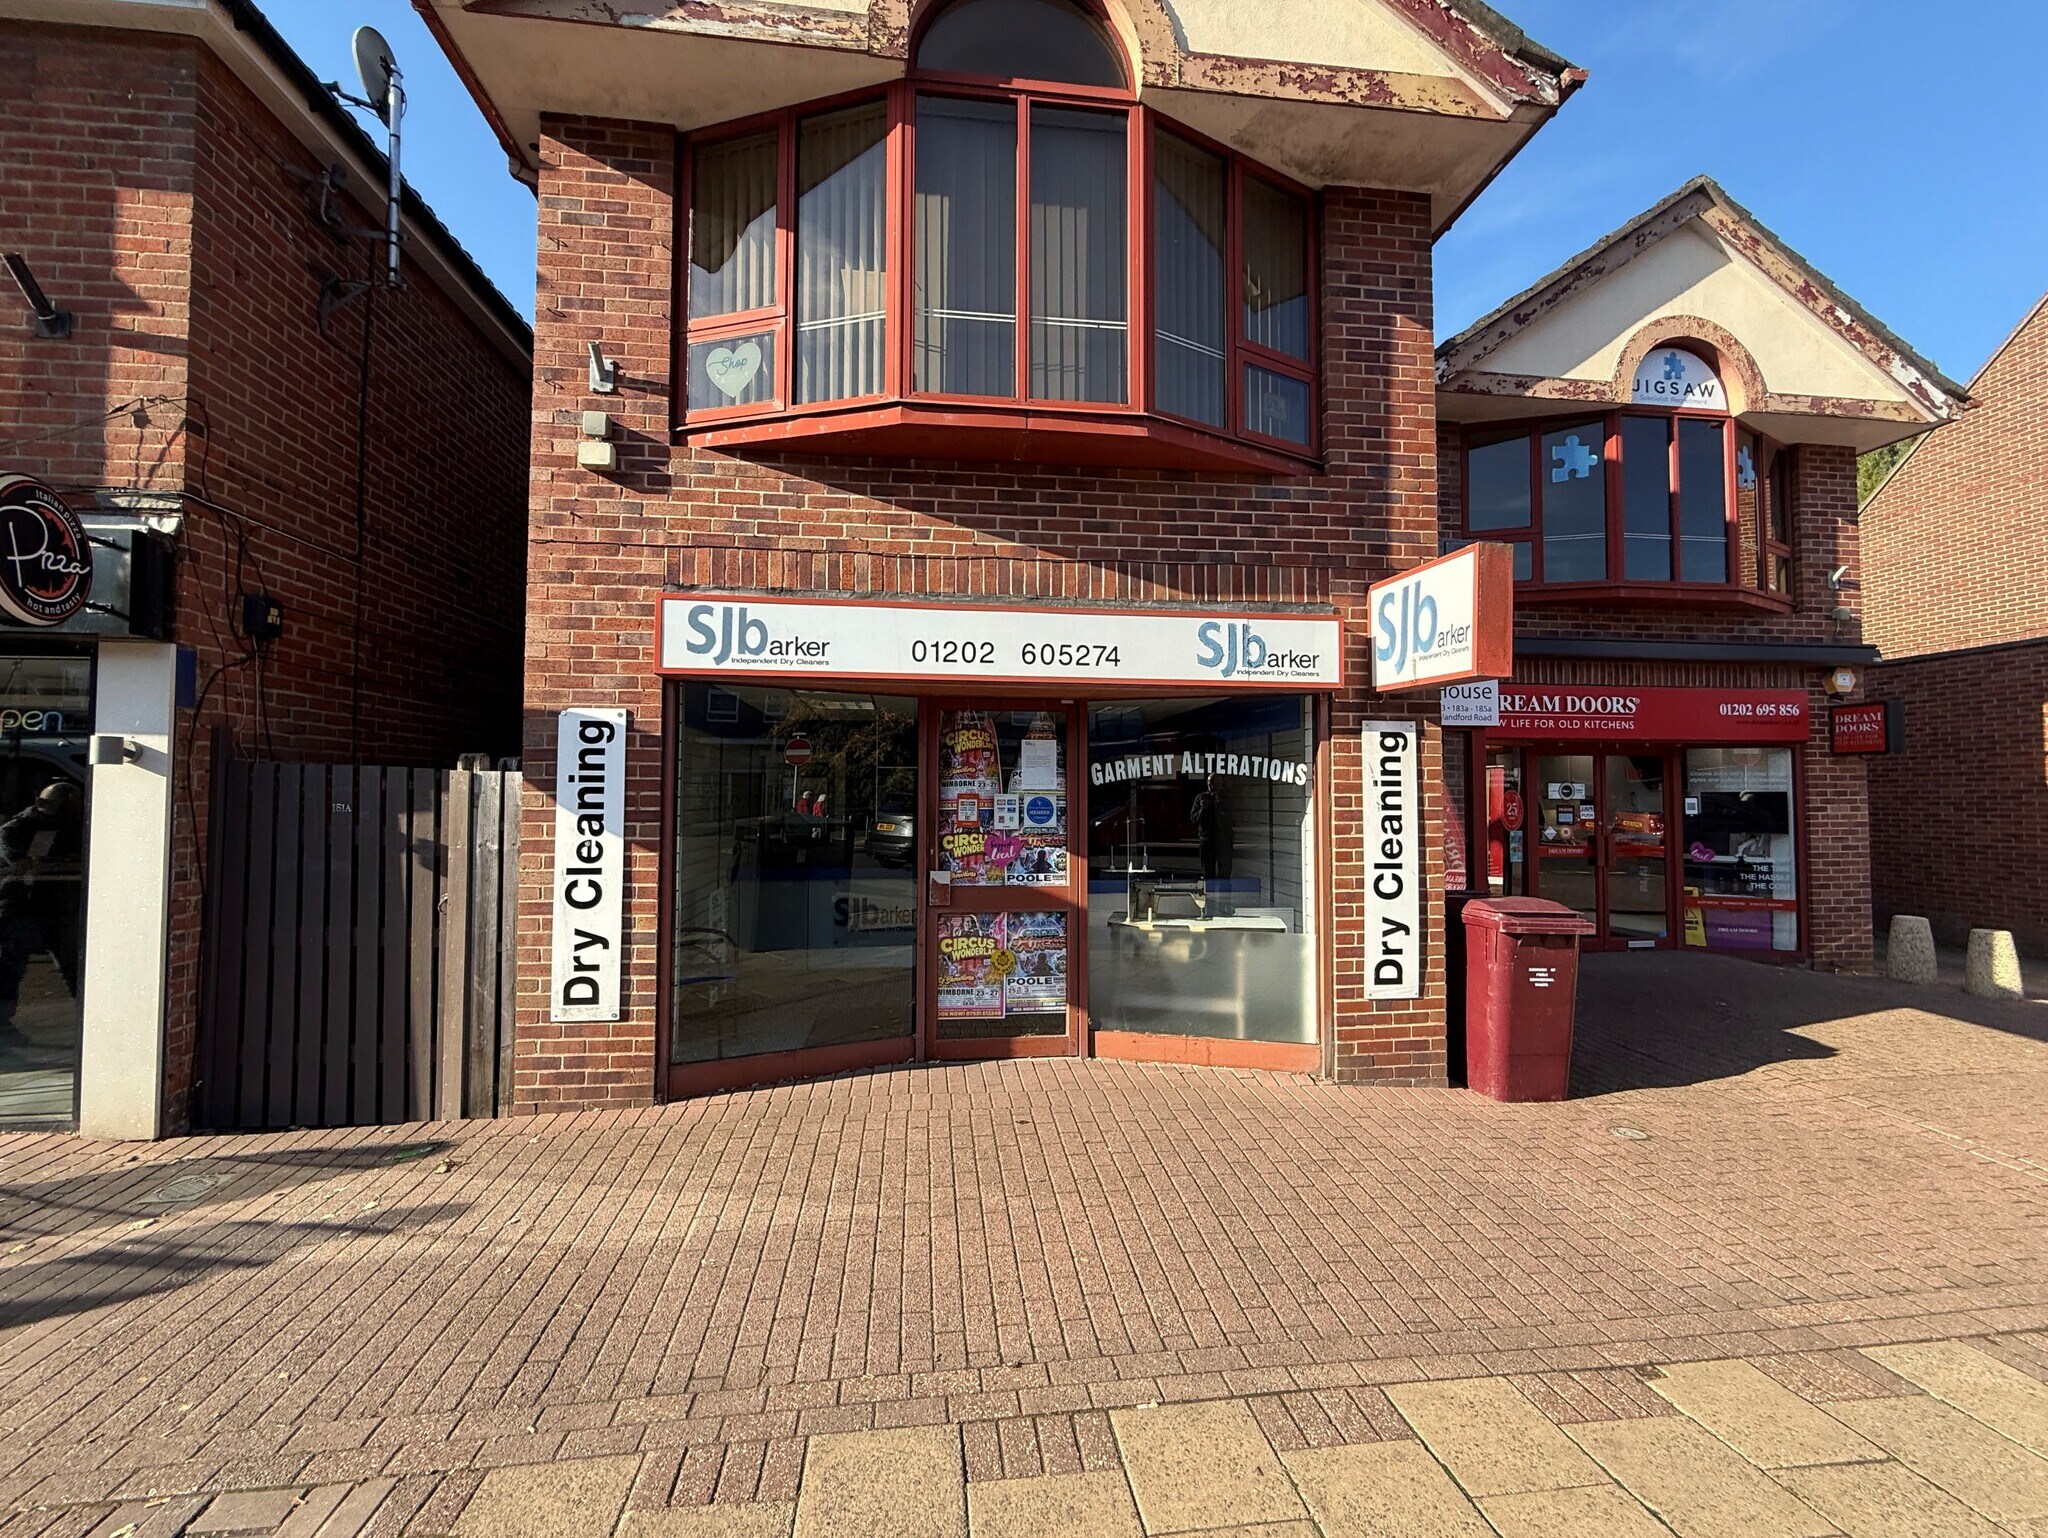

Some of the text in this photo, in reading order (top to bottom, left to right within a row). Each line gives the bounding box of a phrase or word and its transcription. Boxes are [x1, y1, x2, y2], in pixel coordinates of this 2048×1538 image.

[1632, 379, 1715, 397] JIGSAW
[35, 489, 64, 513] Italian
[26, 592, 81, 614] hot and tasty
[911, 640, 1121, 667] 01202 605274
[731, 657, 830, 667] Independent Dry Cleaners
[1236, 669, 1275, 677] Independent
[1277, 670, 1289, 678] Dry
[1452, 704, 1469, 712] 183a
[1499, 695, 1561, 713] REAM
[1719, 703, 1800, 716] 01202 695 856
[1443, 713, 1472, 721] landford
[1835, 712, 1882, 723] DREAM
[0, 709, 63, 738] pen
[1511, 719, 1531, 728] LIFE
[1534, 719, 1555, 728] FOR
[1558, 720, 1581, 729] OLD
[1584, 720, 1635, 729] KITCHENS
[1835, 722, 1880, 733] DOORS
[946, 729, 990, 746] CIRCUS
[1091, 751, 1308, 786] GARMENT ALTERATIONS
[941, 780, 976, 788] WIMBORNE
[1506, 802, 1518, 816] 25
[943, 834, 986, 850] CIRCU
[953, 845, 986, 857] WONDER
[563, 720, 616, 1006] Dry Cleaning
[1373, 731, 1410, 986] Dry Cleaning
[1752, 864, 1769, 872] THE
[1007, 874, 1052, 882] POOLE
[1740, 873, 1756, 881] THE
[1750, 882, 1767, 890] THE
[941, 937, 995, 952] CIRCUS
[951, 949, 995, 961] WONDERLA
[1008, 977, 1053, 985] POOLE
